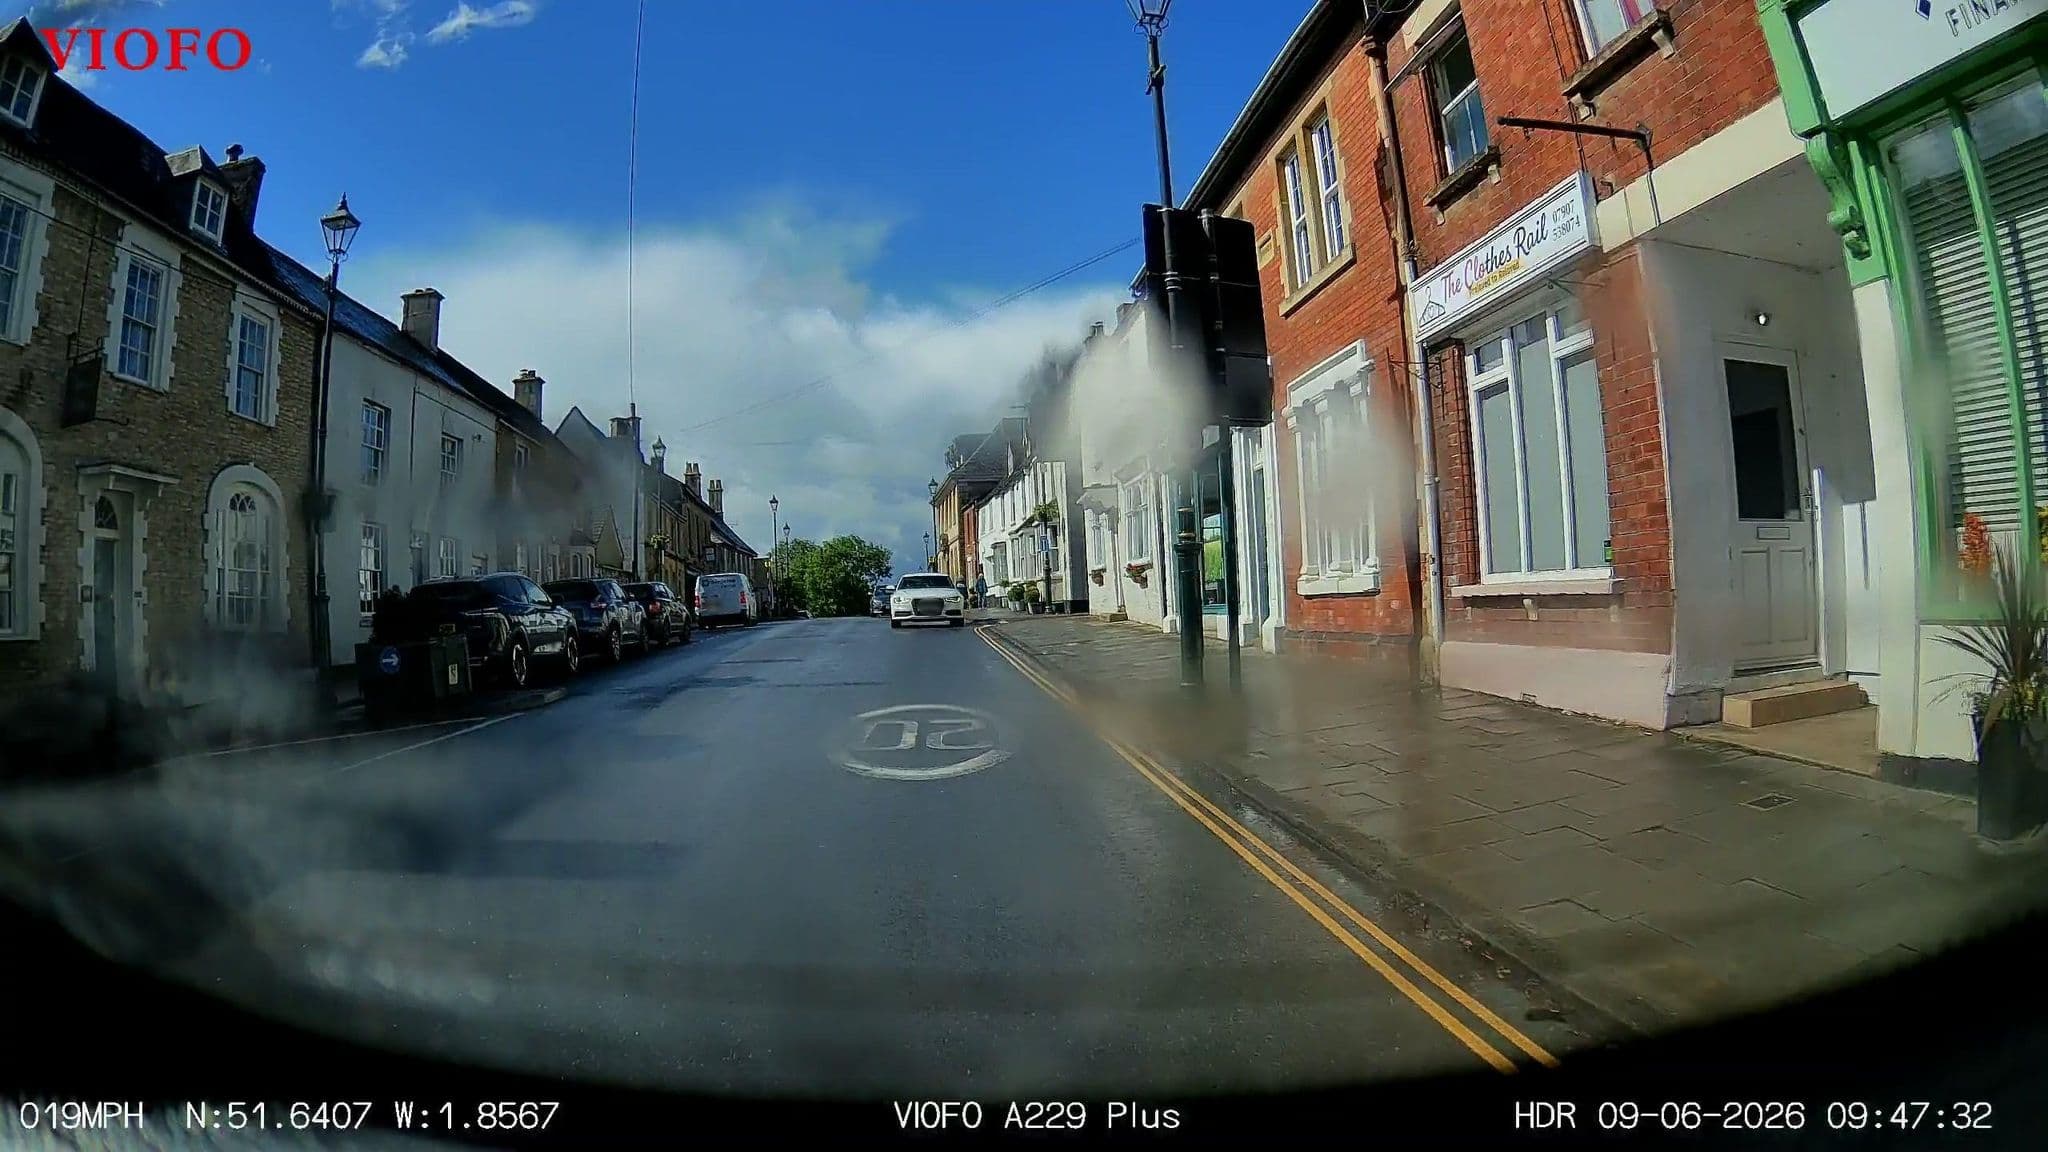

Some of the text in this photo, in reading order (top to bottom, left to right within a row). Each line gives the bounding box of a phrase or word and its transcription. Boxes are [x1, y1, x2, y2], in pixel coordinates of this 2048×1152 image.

[1945, 0, 2016, 37] FINA
[1552, 199, 1575, 223] 07907
[1441, 212, 1549, 303] The Clothes Rail
